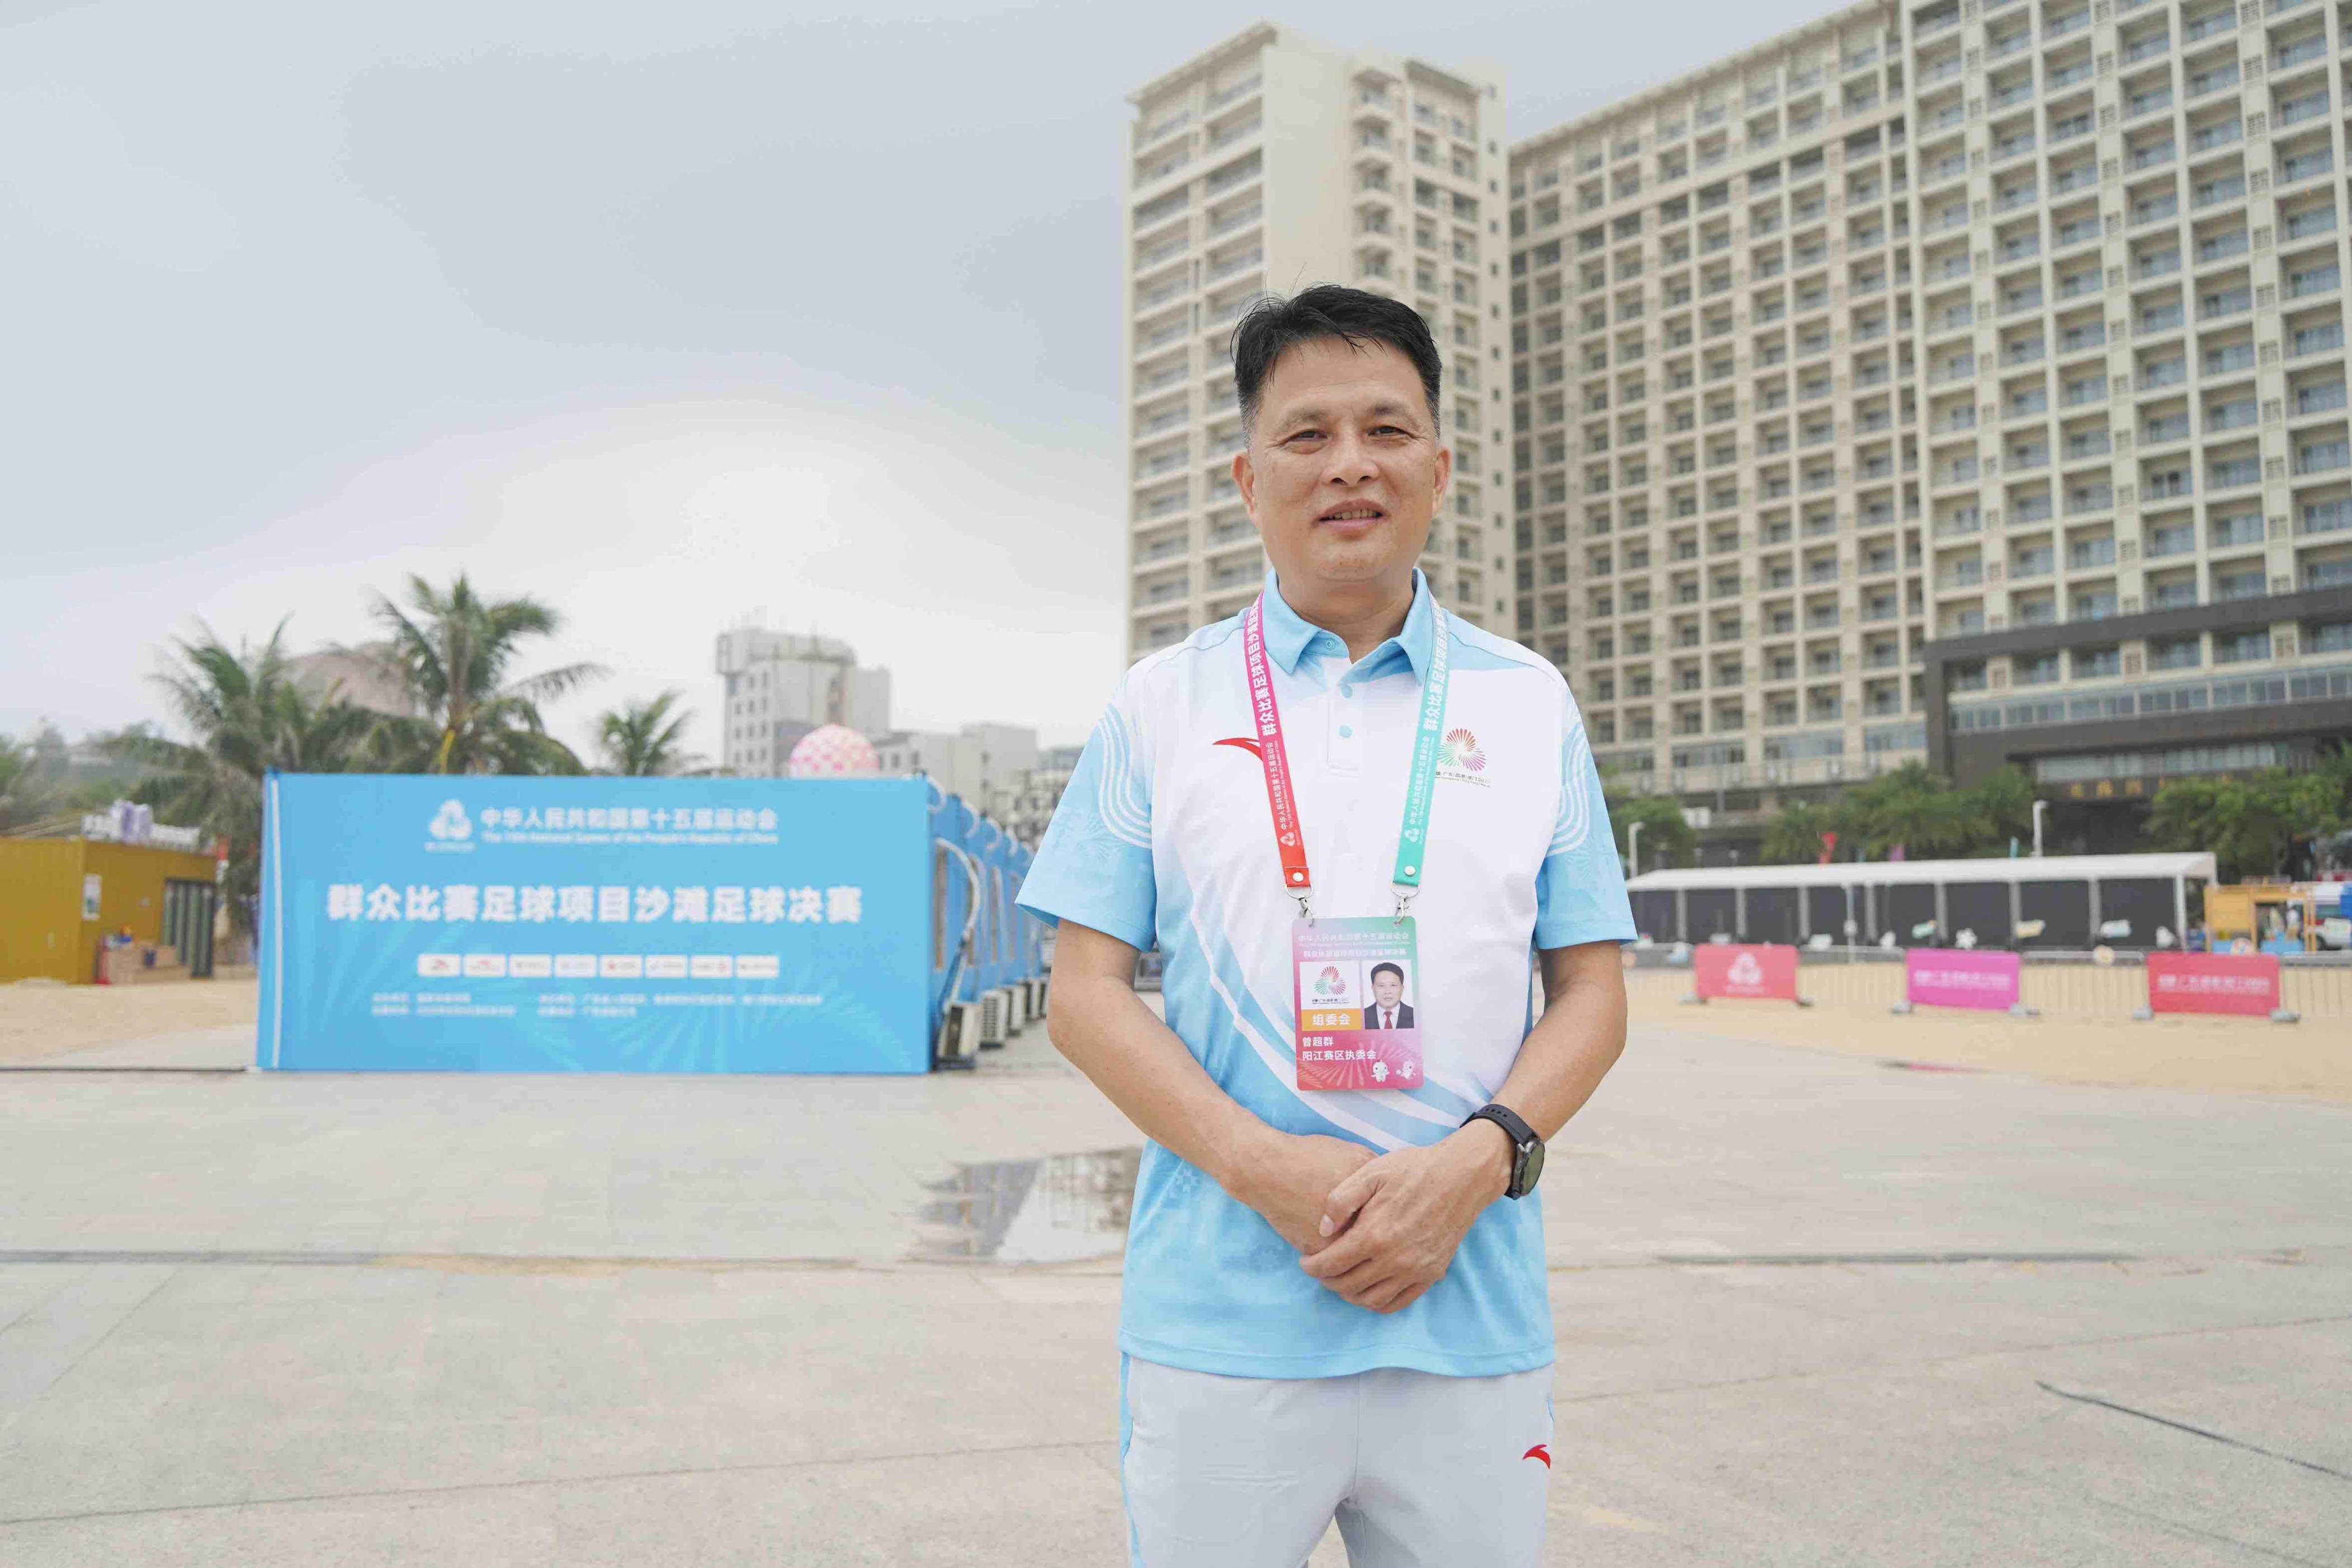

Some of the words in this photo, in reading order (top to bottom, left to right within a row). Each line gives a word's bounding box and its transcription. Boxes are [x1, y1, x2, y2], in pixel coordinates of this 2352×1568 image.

[327, 884, 862, 923] 群众比赛足球项目沙滩足球决赛
[1312, 1013, 1350, 1026] 组委会
[1302, 1036, 1334, 1047] 曾超群
[1302, 1050, 1377, 1061] 阳江赛区执委会
